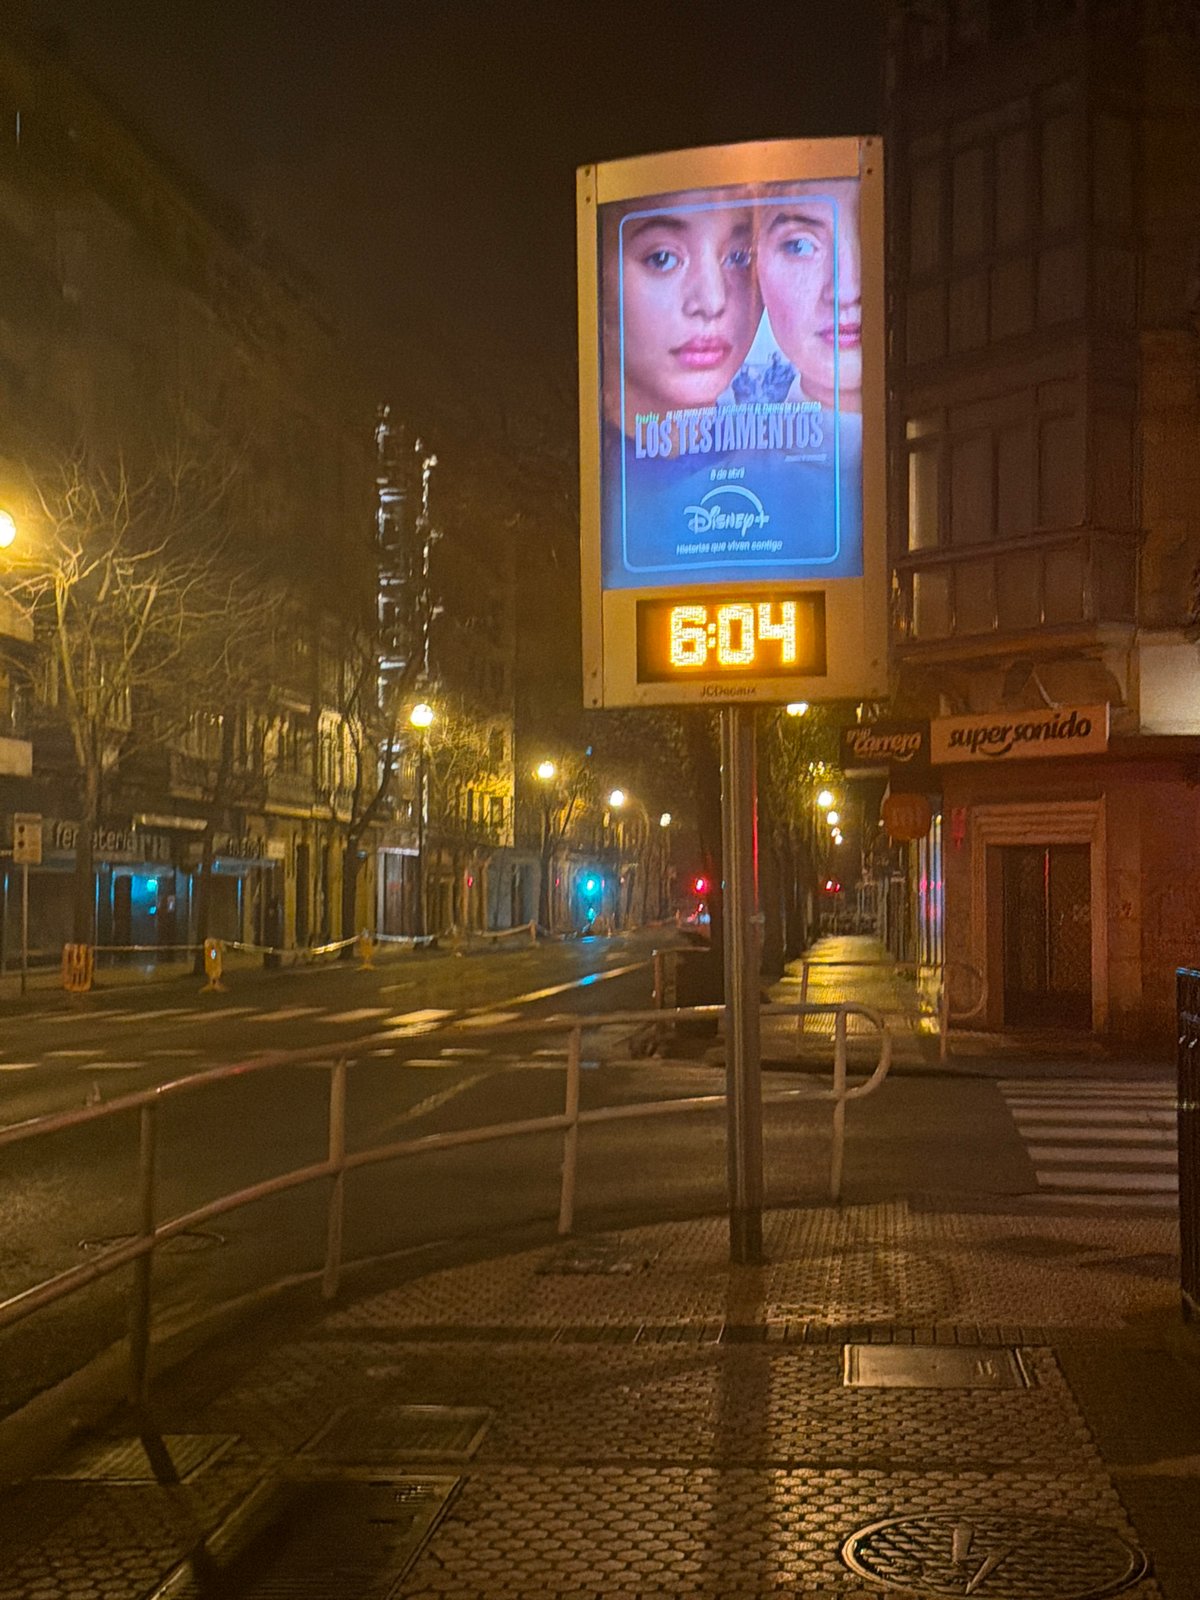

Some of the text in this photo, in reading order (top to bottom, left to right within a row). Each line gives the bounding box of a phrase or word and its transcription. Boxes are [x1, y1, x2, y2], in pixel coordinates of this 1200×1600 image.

[635, 418, 672, 459] LOS
[676, 411, 824, 456] TESTAMENTOS
[670, 601, 796, 667] 6:04
[948, 711, 1092, 755] supersonido
